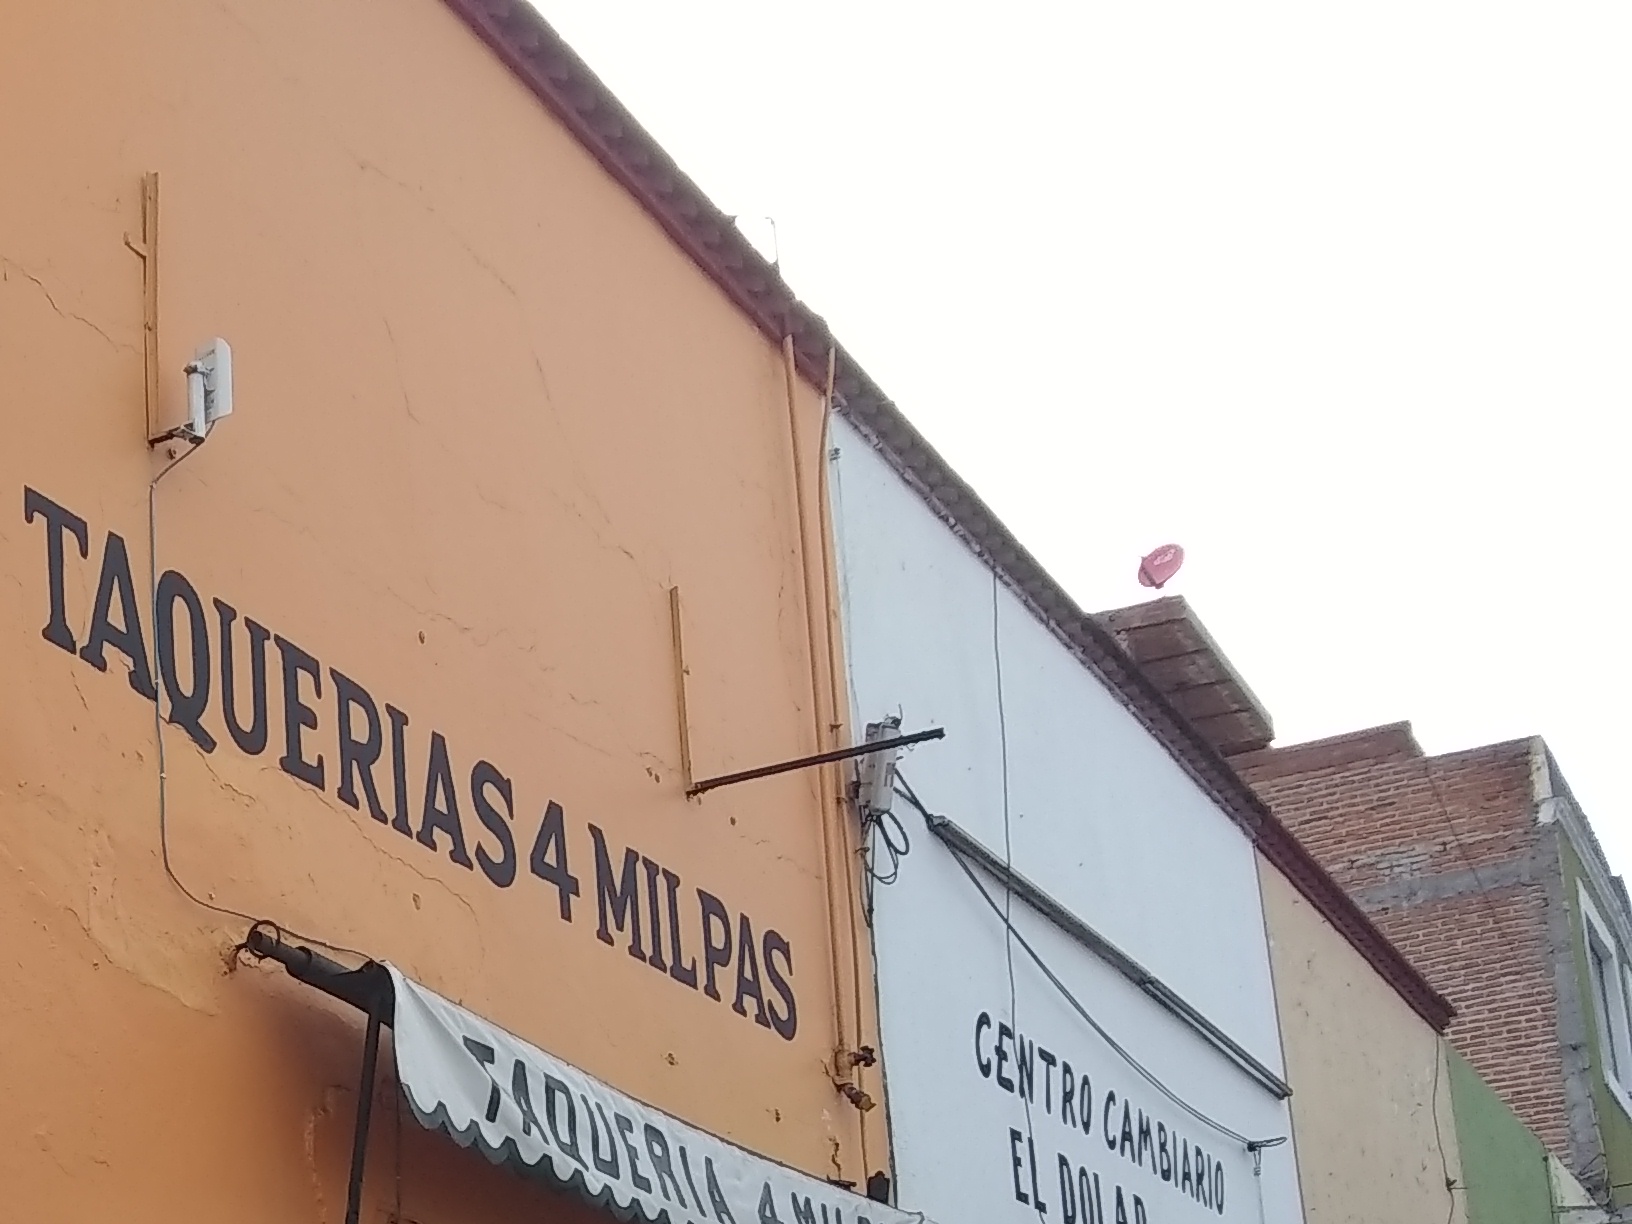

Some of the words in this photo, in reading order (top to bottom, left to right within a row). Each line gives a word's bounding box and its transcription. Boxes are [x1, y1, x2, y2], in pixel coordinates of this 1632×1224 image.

[24, 485, 517, 888] TAQUERIAS
[530, 801, 580, 923] 4
[588, 824, 798, 1042] MILPAS
[974, 1010, 1092, 1135] CENTRO
[1103, 1090, 1226, 1215] CAMBIARIO
[1009, 1126, 1047, 1214] EL
